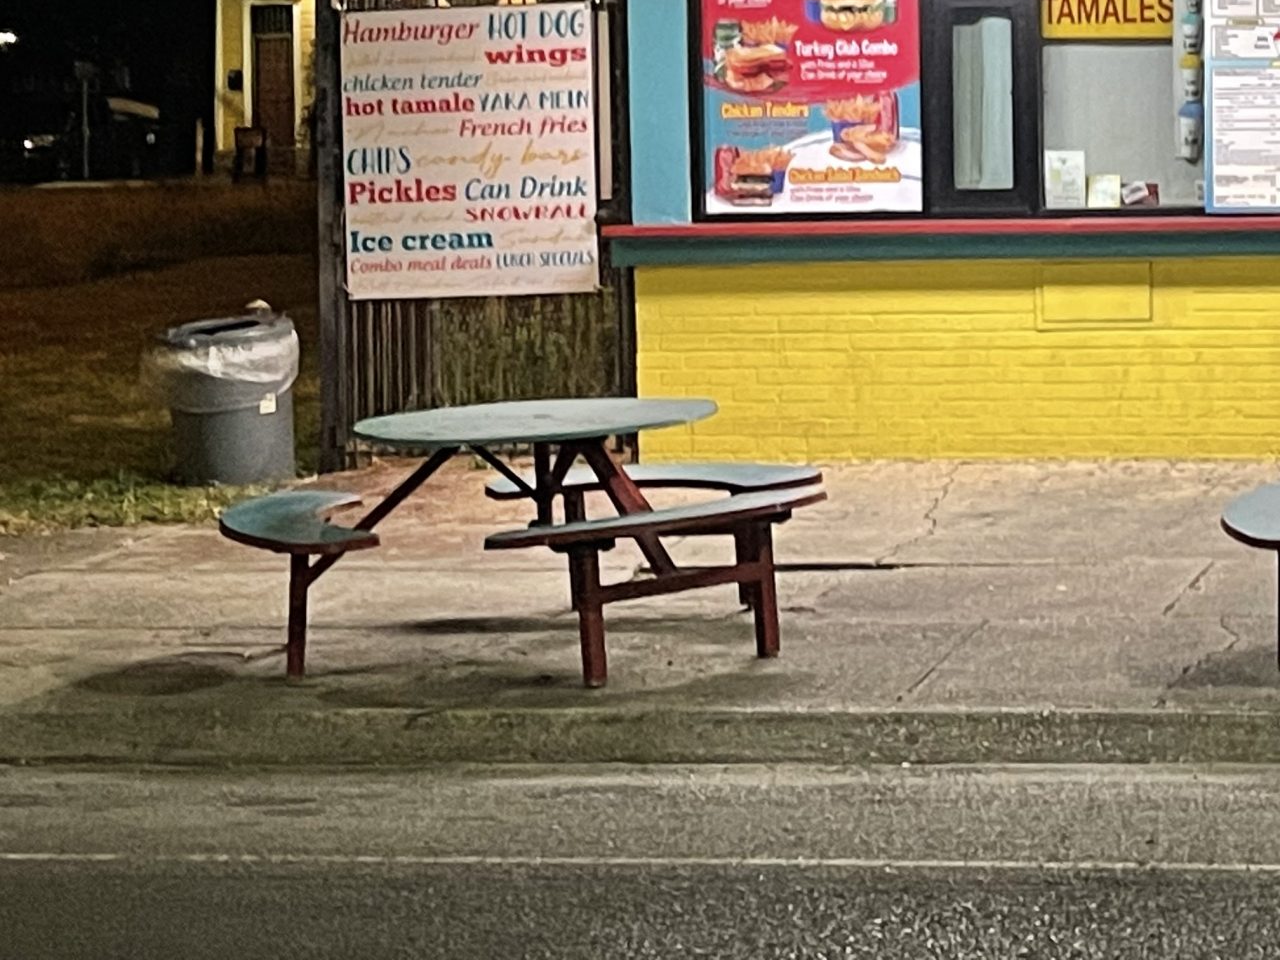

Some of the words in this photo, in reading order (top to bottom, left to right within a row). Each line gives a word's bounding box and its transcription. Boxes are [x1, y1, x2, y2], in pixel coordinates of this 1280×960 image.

[343, 19, 480, 45] Hamburger
[488, 11, 529, 40] HOT
[539, 8, 585, 38] DOG
[484, 43, 587, 68] wings
[795, 40, 834, 60] Turkey
[861, 40, 898, 55] Combo
[343, 73, 414, 92] chicken
[420, 70, 483, 89] tender
[345, 97, 384, 117] hot
[391, 92, 476, 114] tamale
[478, 91, 531, 113] YAKA
[458, 116, 532, 139] French
[538, 114, 588, 139] fries
[347, 145, 412, 175] CHIPS
[348, 178, 458, 205] Pickles
[464, 178, 511, 202] Can
[518, 175, 588, 200] Drink
[464, 202, 588, 224] SNOWBALL
[349, 230, 393, 253] Ice
[401, 230, 494, 251] cream
[350, 258, 403, 275] Combo
[408, 254, 447, 271] meal
[450, 253, 493, 270] deals
